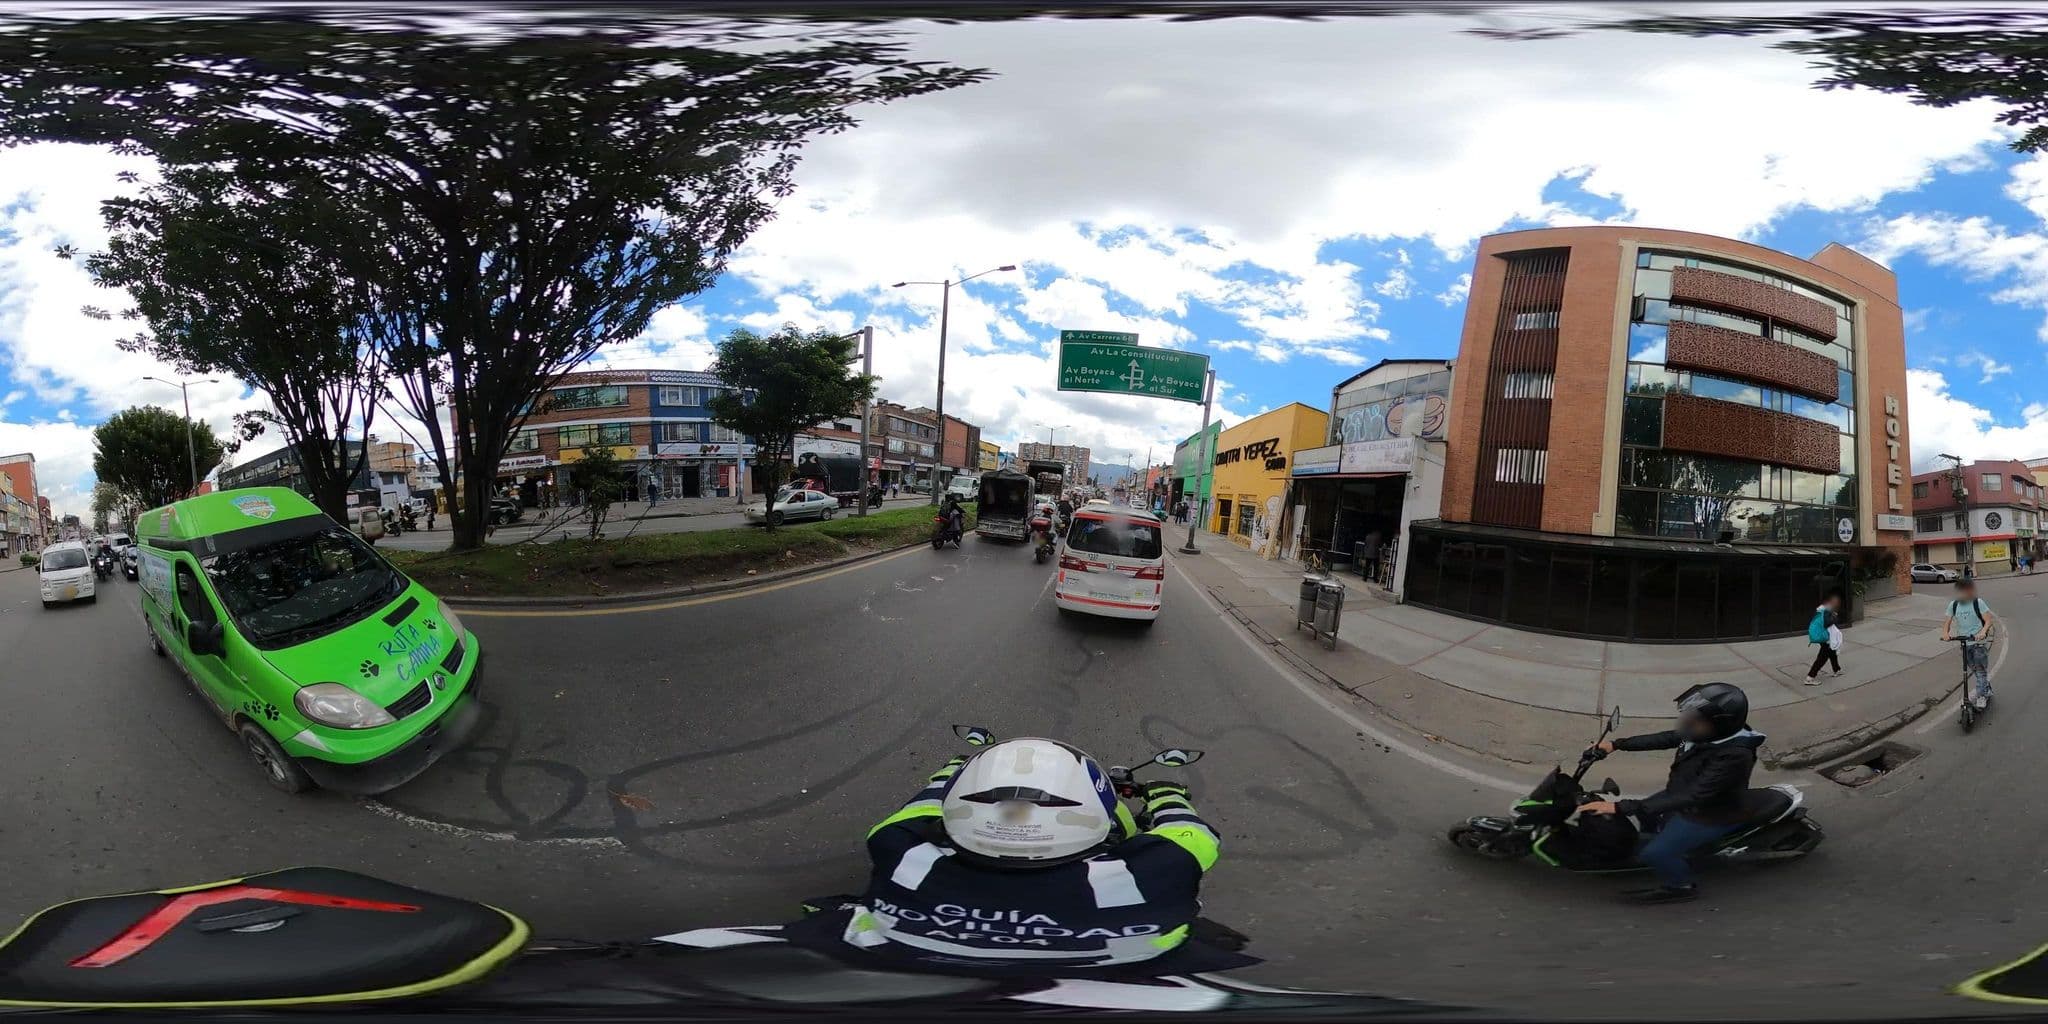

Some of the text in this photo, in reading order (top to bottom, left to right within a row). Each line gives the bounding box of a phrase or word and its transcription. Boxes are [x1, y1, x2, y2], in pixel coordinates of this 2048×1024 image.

[1091, 333, 1121, 341] Carrera
[1090, 347, 1104, 355] Av
[1106, 348, 1118, 356] La
[1065, 366, 1079, 374] Av
[1074, 376, 1101, 384] Norte
[1150, 375, 1164, 383] Av
[1149, 385, 1177, 395] al Sur
[1884, 395, 1904, 510] HOTEL
[378, 624, 420, 656] RUTA
[874, 898, 1160, 938] MOVILIDAD
[933, 903, 1059, 926] GUÍA
